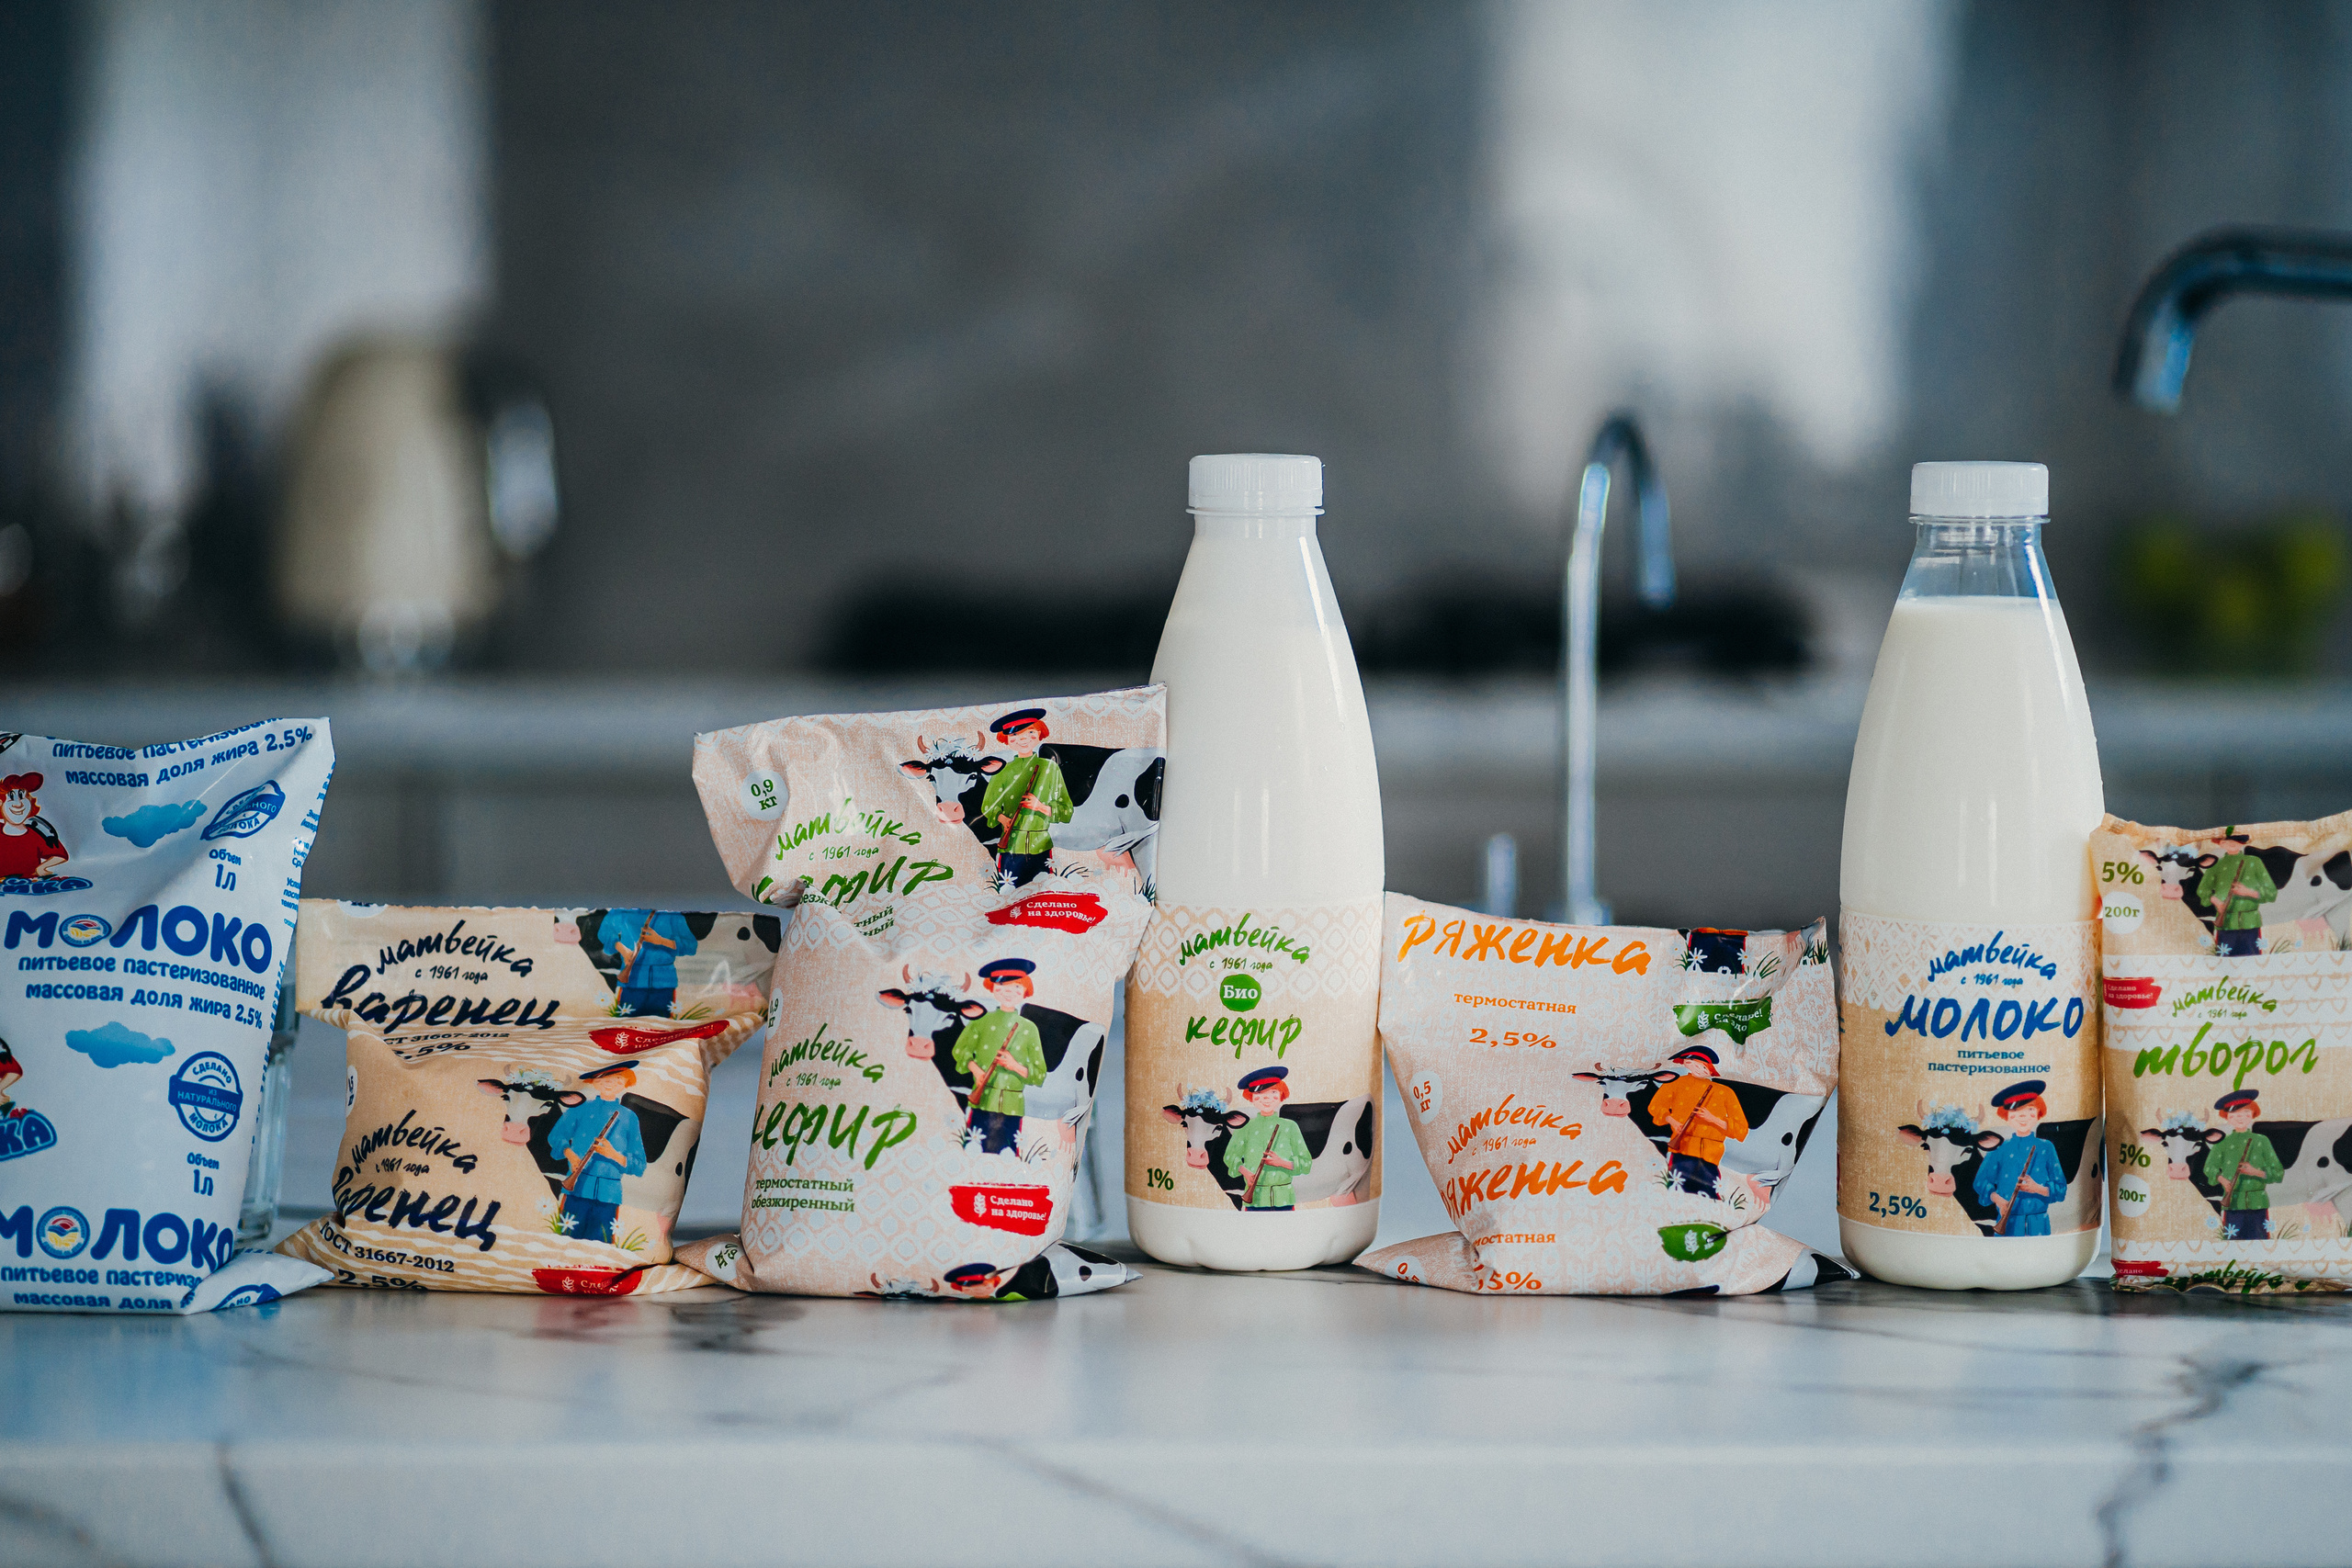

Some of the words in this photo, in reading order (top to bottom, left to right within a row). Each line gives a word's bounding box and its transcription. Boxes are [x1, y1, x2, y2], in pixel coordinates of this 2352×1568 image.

[52, 742, 136, 761] питьевое
[65, 771, 149, 787] массовая
[156, 758, 205, 784] доля
[210, 740, 260, 766] жира
[264, 726, 313, 752] 2,5%
[751, 779, 775, 798] 0,9
[760, 796, 778, 811] кг
[775, 797, 922, 861] матвейка
[808, 852, 815, 861] с
[821, 846, 851, 861] 1961
[854, 845, 879, 860] года
[2101, 862, 2144, 885] 5%
[1045, 910, 1096, 923] здоровье!
[2104, 907, 2140, 918] 200г
[377, 919, 534, 977] матвейка
[1180, 913, 1310, 965] матвейка
[1397, 909, 1652, 976] ряженка
[1209, 961, 1215, 969] с
[1222, 957, 1247, 970] 1961
[1250, 963, 1273, 972] года
[1928, 931, 2057, 982] матвейка
[18, 956, 116, 972] питьевое
[124, 957, 266, 1000] пастеризованное
[415, 969, 422, 978] с
[430, 965, 460, 980] 1961
[462, 971, 488, 983] года
[1961, 976, 1966, 985] с
[1973, 974, 1999, 987] 1961
[2002, 977, 2024, 987] года
[1223, 986, 1259, 999] Био
[2173, 976, 2278, 1018] матвейка
[26, 983, 123, 1001] массовая
[130, 988, 183, 1010] доля
[189, 996, 231, 1020] жира
[235, 1005, 264, 1030] 2,5%
[1453, 993, 1577, 1014] термостатная
[2207, 1009, 2227, 1019] 1961
[2231, 1011, 2248, 1020] года
[411, 1032, 510, 1043] 31667-2012
[1185, 1013, 1303, 1059] кефир
[1469, 1028, 1557, 1050] 2,5%
[769, 1022, 885, 1088] матвейка
[1957, 1049, 2025, 1059] питьевое
[2133, 1021, 2319, 1091] творог
[192, 1061, 232, 1084] СДЕЛАНО
[1928, 1062, 2051, 1075] пастеризованное
[786, 1077, 791, 1087] с
[796, 1073, 820, 1087] 1961
[820, 1076, 842, 1089] года
[1412, 1080, 1432, 1100] 0,5
[177, 1090, 238, 1112] НАТУРАЛЬНОГО
[1419, 1098, 1431, 1114] кг
[188, 1111, 229, 1134] МОЛОКА
[1447, 1094, 1583, 1164] матвейка
[352, 1110, 479, 1174] матвейка
[1472, 1145, 1477, 1156] с
[1483, 1136, 1509, 1153] 1961
[1511, 1136, 1537, 1148] года
[2120, 1143, 2151, 1168] 5%
[376, 1163, 380, 1173] с
[381, 1158, 402, 1172] 1961
[403, 1162, 429, 1176] года
[193, 1169, 213, 1196] 1л
[755, 1178, 854, 1192] термостатный
[1147, 1168, 1174, 1191] 1%
[751, 1196, 855, 1212] обезжиренный
[990, 1194, 1034, 1208] Сделано
[1869, 1192, 1928, 1219] 2,5%
[2119, 1188, 2146, 1203] 200г
[991, 1209, 1004, 1217] на
[1006, 1209, 1047, 1221] здоровье!
[320, 1222, 352, 1255] ГОСТ
[355, 1247, 455, 1272] 31667-2012
[0, 1266, 98, 1284] питьевое
[338, 1269, 428, 1291] 2,5%
[14, 1292, 110, 1310] массовая
[119, 1295, 173, 1311] доля
